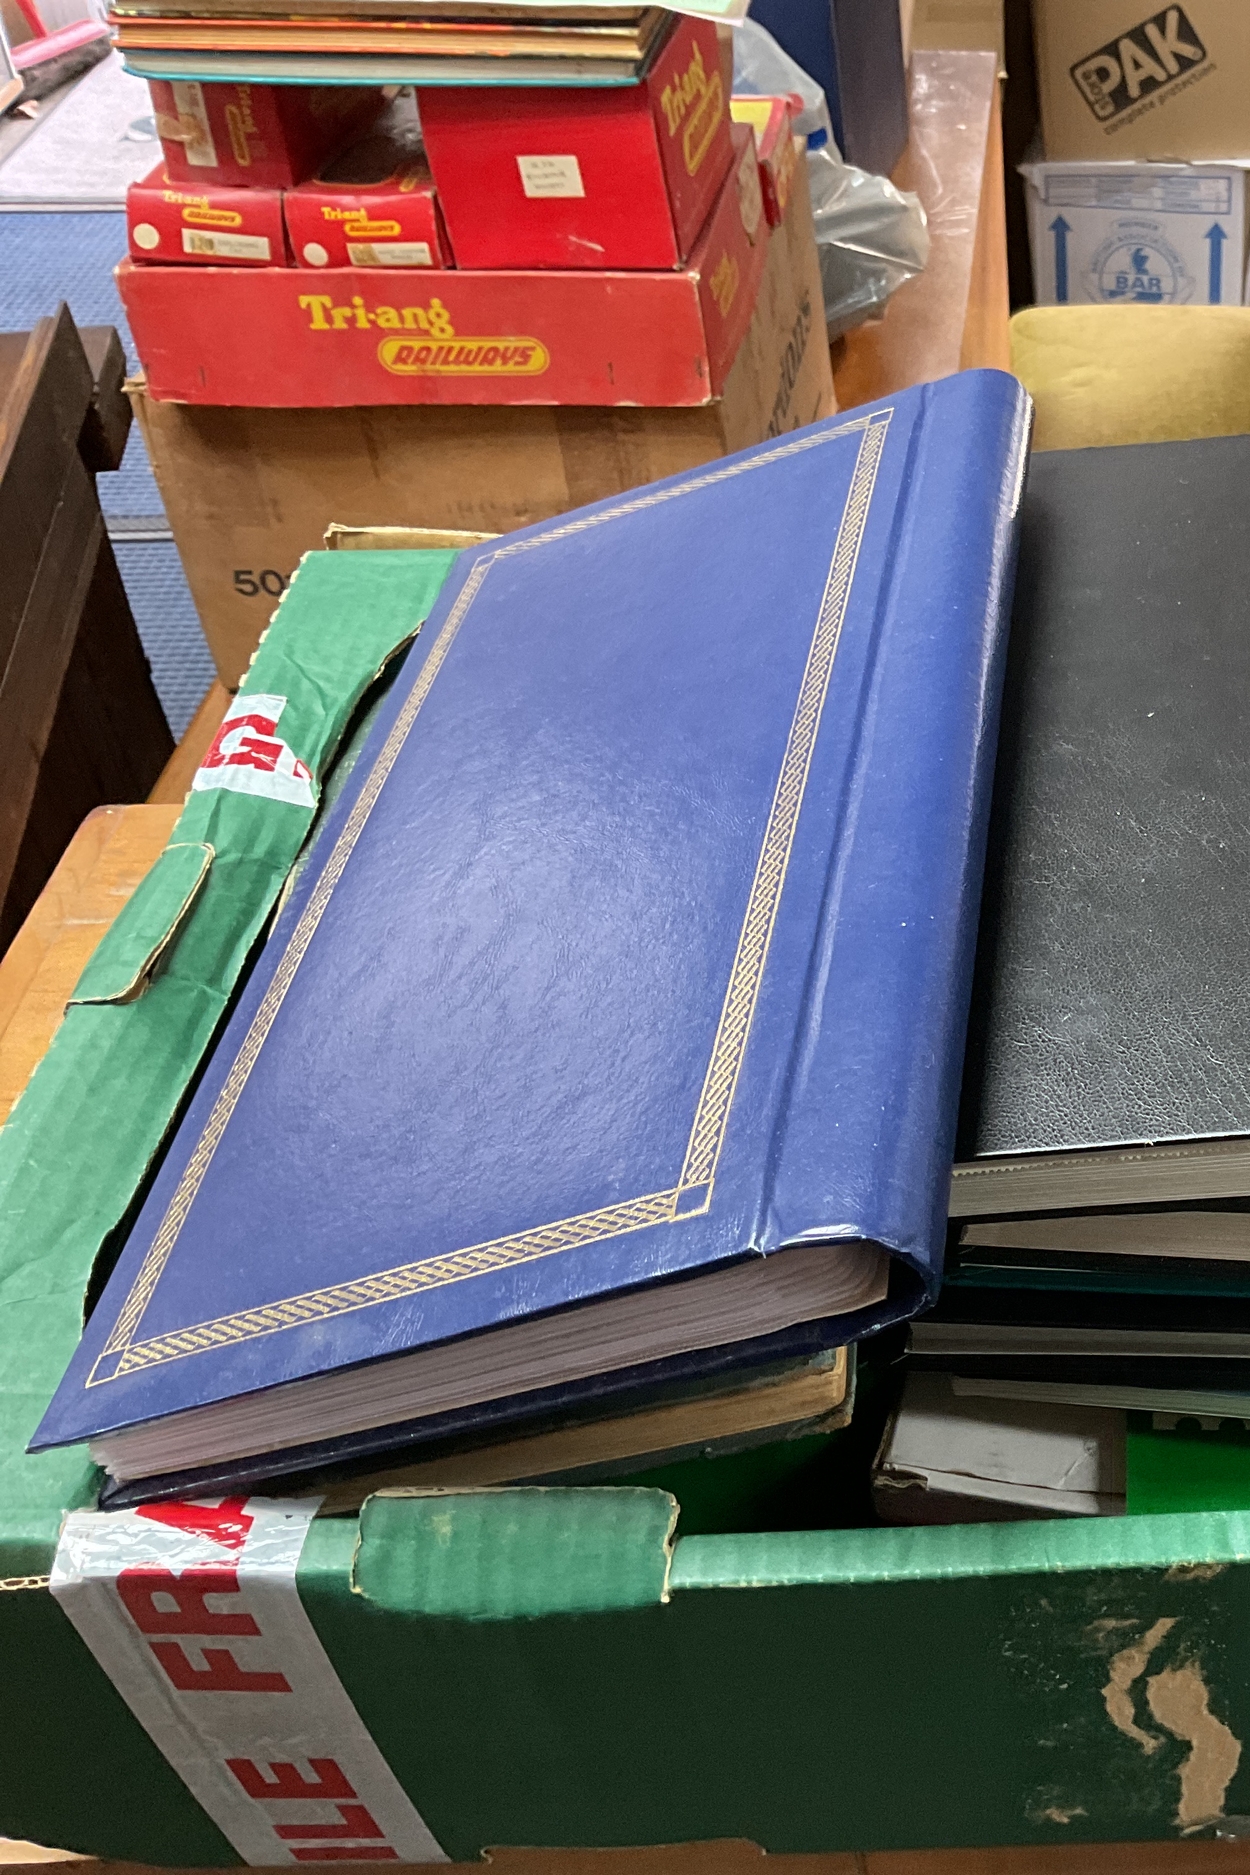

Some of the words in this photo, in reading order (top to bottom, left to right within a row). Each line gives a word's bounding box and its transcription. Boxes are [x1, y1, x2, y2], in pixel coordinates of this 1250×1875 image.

[1073, 9, 1203, 100] PAK
[1115, 276, 1161, 293] BAR
[298, 294, 455, 340] Tri-ang
[391, 346, 537, 367] RAILWAYS
[233, 569, 294, 597] 50
